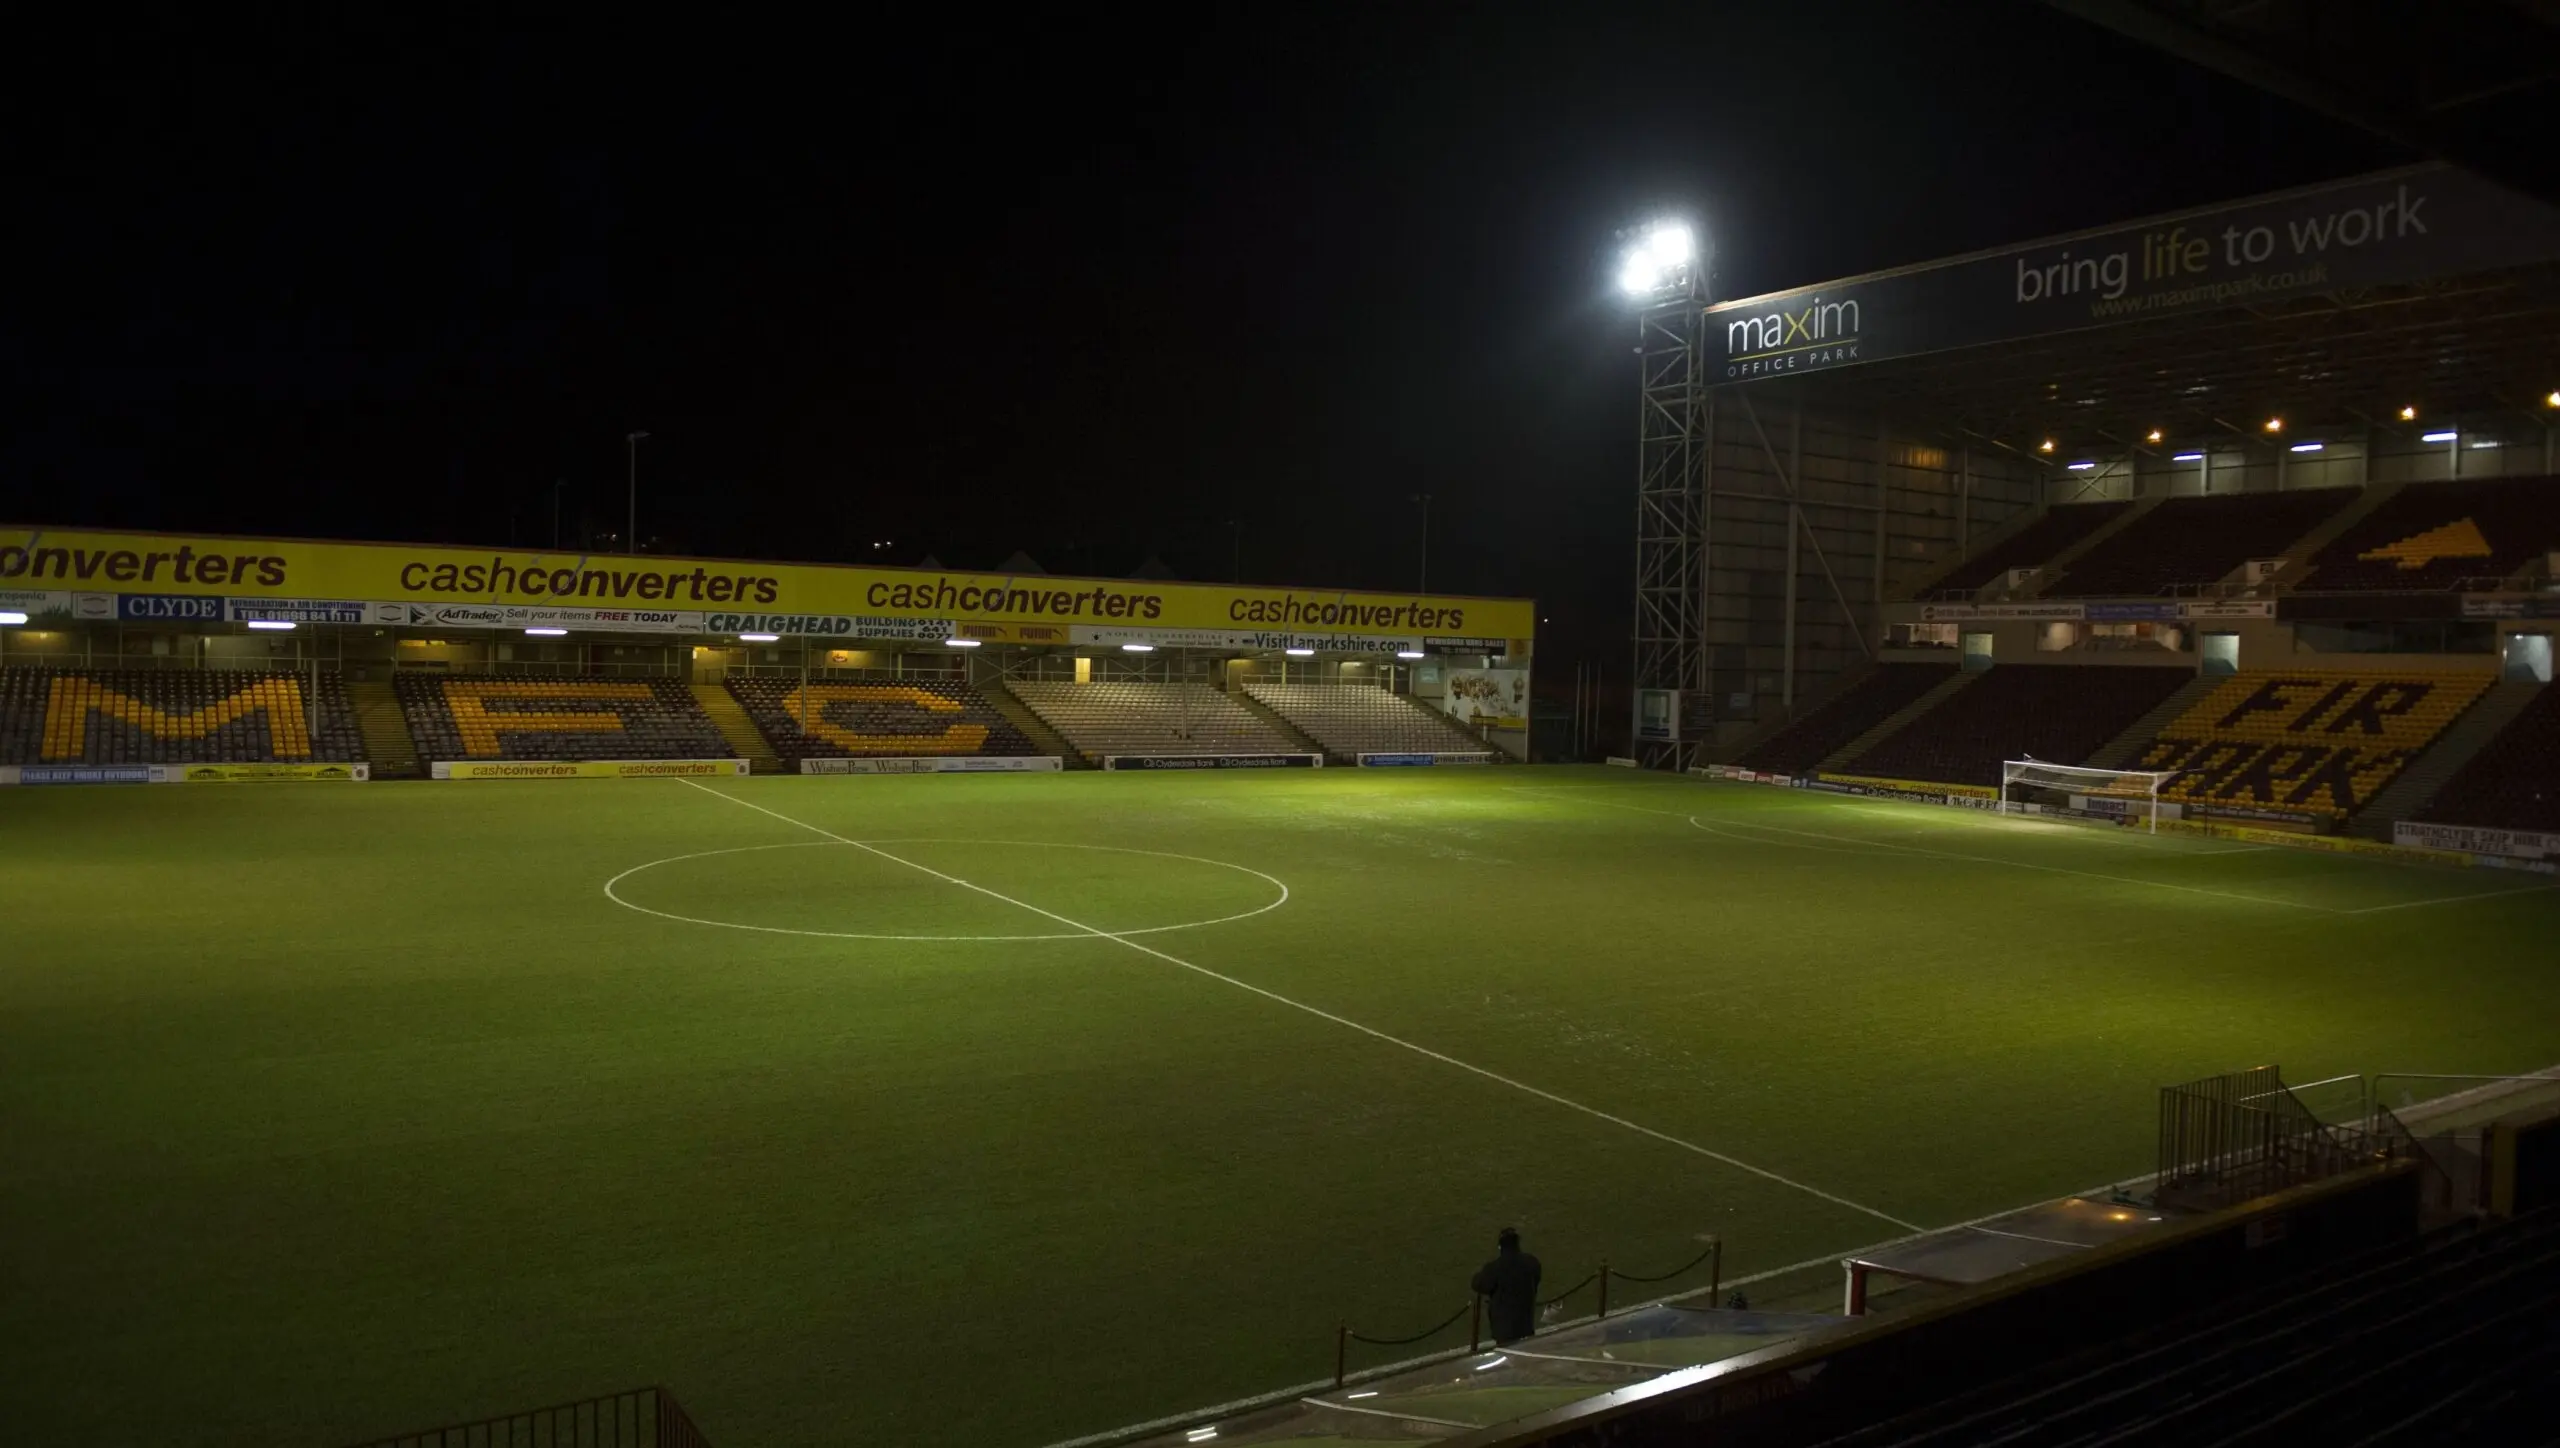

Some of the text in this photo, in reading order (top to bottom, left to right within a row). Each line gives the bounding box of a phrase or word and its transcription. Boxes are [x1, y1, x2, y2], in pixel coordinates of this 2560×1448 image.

[2016, 183, 2428, 304] bring life to work
[2090, 262, 2329, 318] www.maximpark.co.uk
[1728, 297, 1860, 355] maxim
[1727, 345, 1859, 377] OFFICE PARK
[400, 557, 778, 604] cashconverters
[128, 598, 217, 617] CLYDE
[867, 577, 1162, 619] cashconverters
[1229, 594, 1464, 630] cashconverters
[442, 610, 498, 620] AdTrader
[506, 609, 677, 622] Sell your items FREE TODAY
[708, 614, 851, 634] CRAIGHEAD
[856, 616, 916, 627] BUILDING
[857, 627, 914, 637] SUPPLIES
[41, 677, 990, 758] M F C
[2213, 679, 2434, 733] FIR
[472, 764, 577, 776] cashconverters
[618, 763, 717, 774] cashconverters
